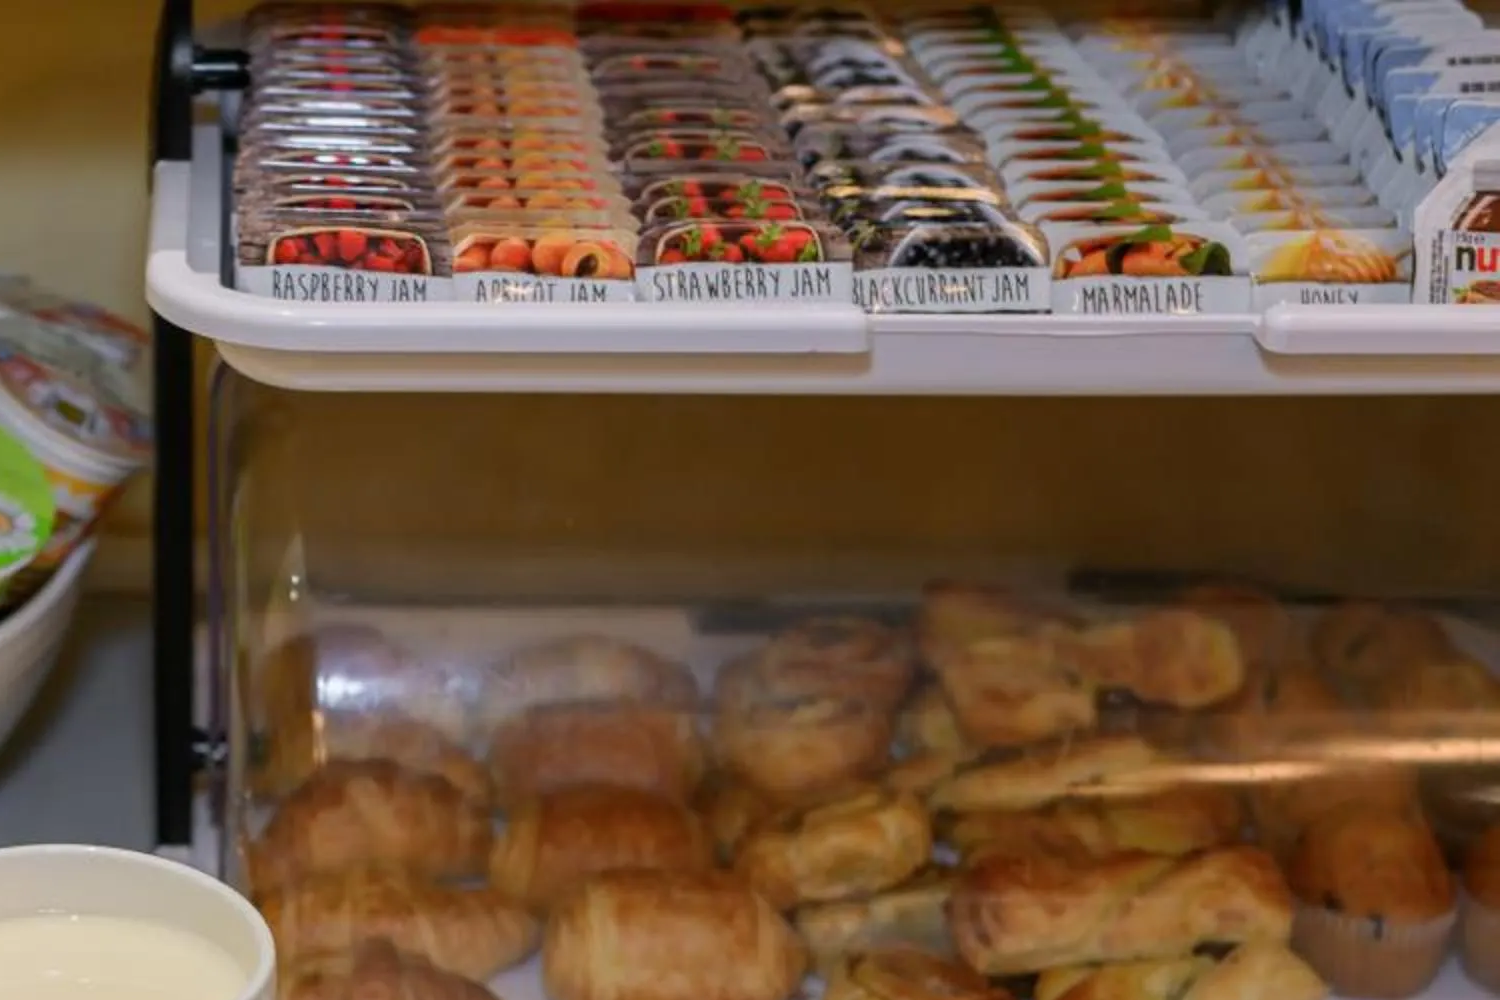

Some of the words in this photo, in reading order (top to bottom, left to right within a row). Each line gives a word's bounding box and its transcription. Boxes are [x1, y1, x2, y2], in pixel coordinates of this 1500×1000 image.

[1455, 245, 1500, 272] nu
[272, 268, 378, 301] RASPBERRY
[389, 276, 427, 301] JAM
[570, 283, 607, 302] JAM
[652, 267, 781, 301] STRAWBERRY
[790, 268, 832, 297] JAM
[852, 272, 989, 308] BLACKCURRANT
[992, 273, 1030, 303] JAM
[1081, 283, 1204, 314] MARMALADE
